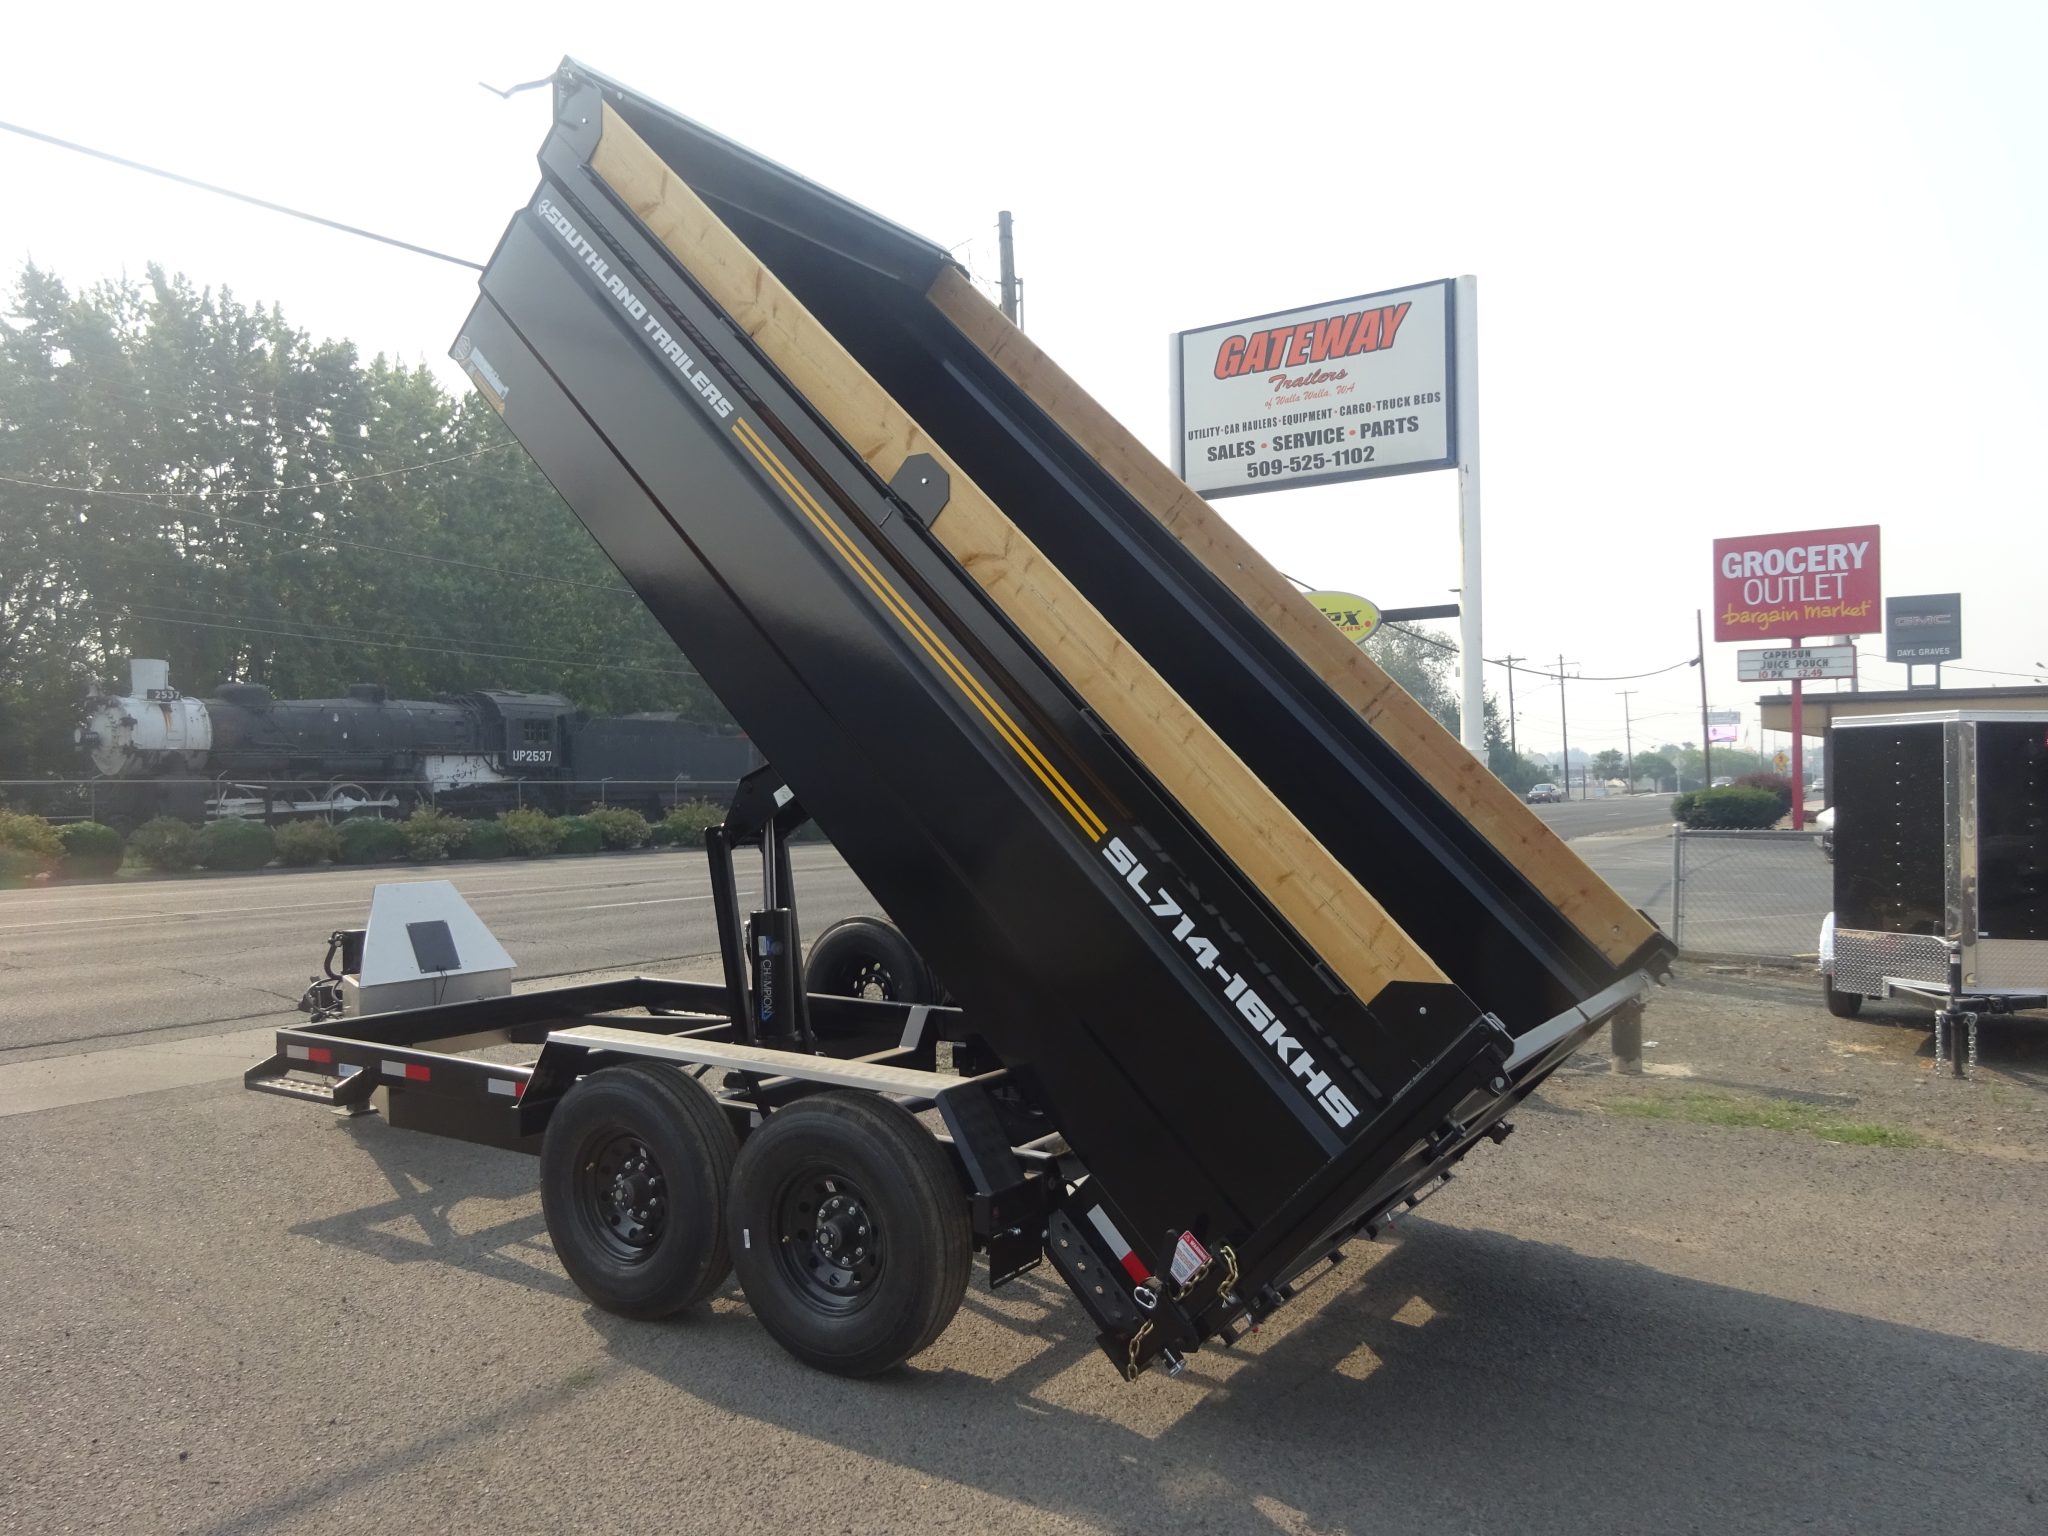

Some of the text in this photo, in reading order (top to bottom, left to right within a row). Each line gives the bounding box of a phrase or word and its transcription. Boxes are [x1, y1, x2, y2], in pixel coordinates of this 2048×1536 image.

[547, 206, 734, 418] SOUTHLAND TRAILERS
[1213, 301, 1412, 380] GATEWAY
[1268, 368, 1348, 393] Trailers
[1265, 399, 1273, 409] of
[1275, 393, 1301, 406] Walla
[1336, 382, 1356, 395] WA
[1188, 391, 1441, 441] UTILITY CAR HAULERS EQUIPMENT CARGO TRUCK BEDS
[1207, 415, 1419, 462] SALES SERVICE PARTS
[1247, 445, 1375, 478] 509-525-1102
[1721, 541, 1869, 579] GROCERY
[1743, 572, 1848, 605] OUTLET
[1721, 600, 1871, 630] bargain market
[1895, 613, 1951, 627] GMC
[1760, 658, 1829, 669] JUICE POUCH
[1762, 649, 1811, 660] CAPRISUN
[1896, 647, 1951, 657] DAYL GRAVES
[1758, 668, 1823, 679] 10 PK $2.49
[154, 690, 180, 699] 2537
[512, 750, 553, 762] UP2537
[1102, 837, 1359, 1128] SL714-16KHS
